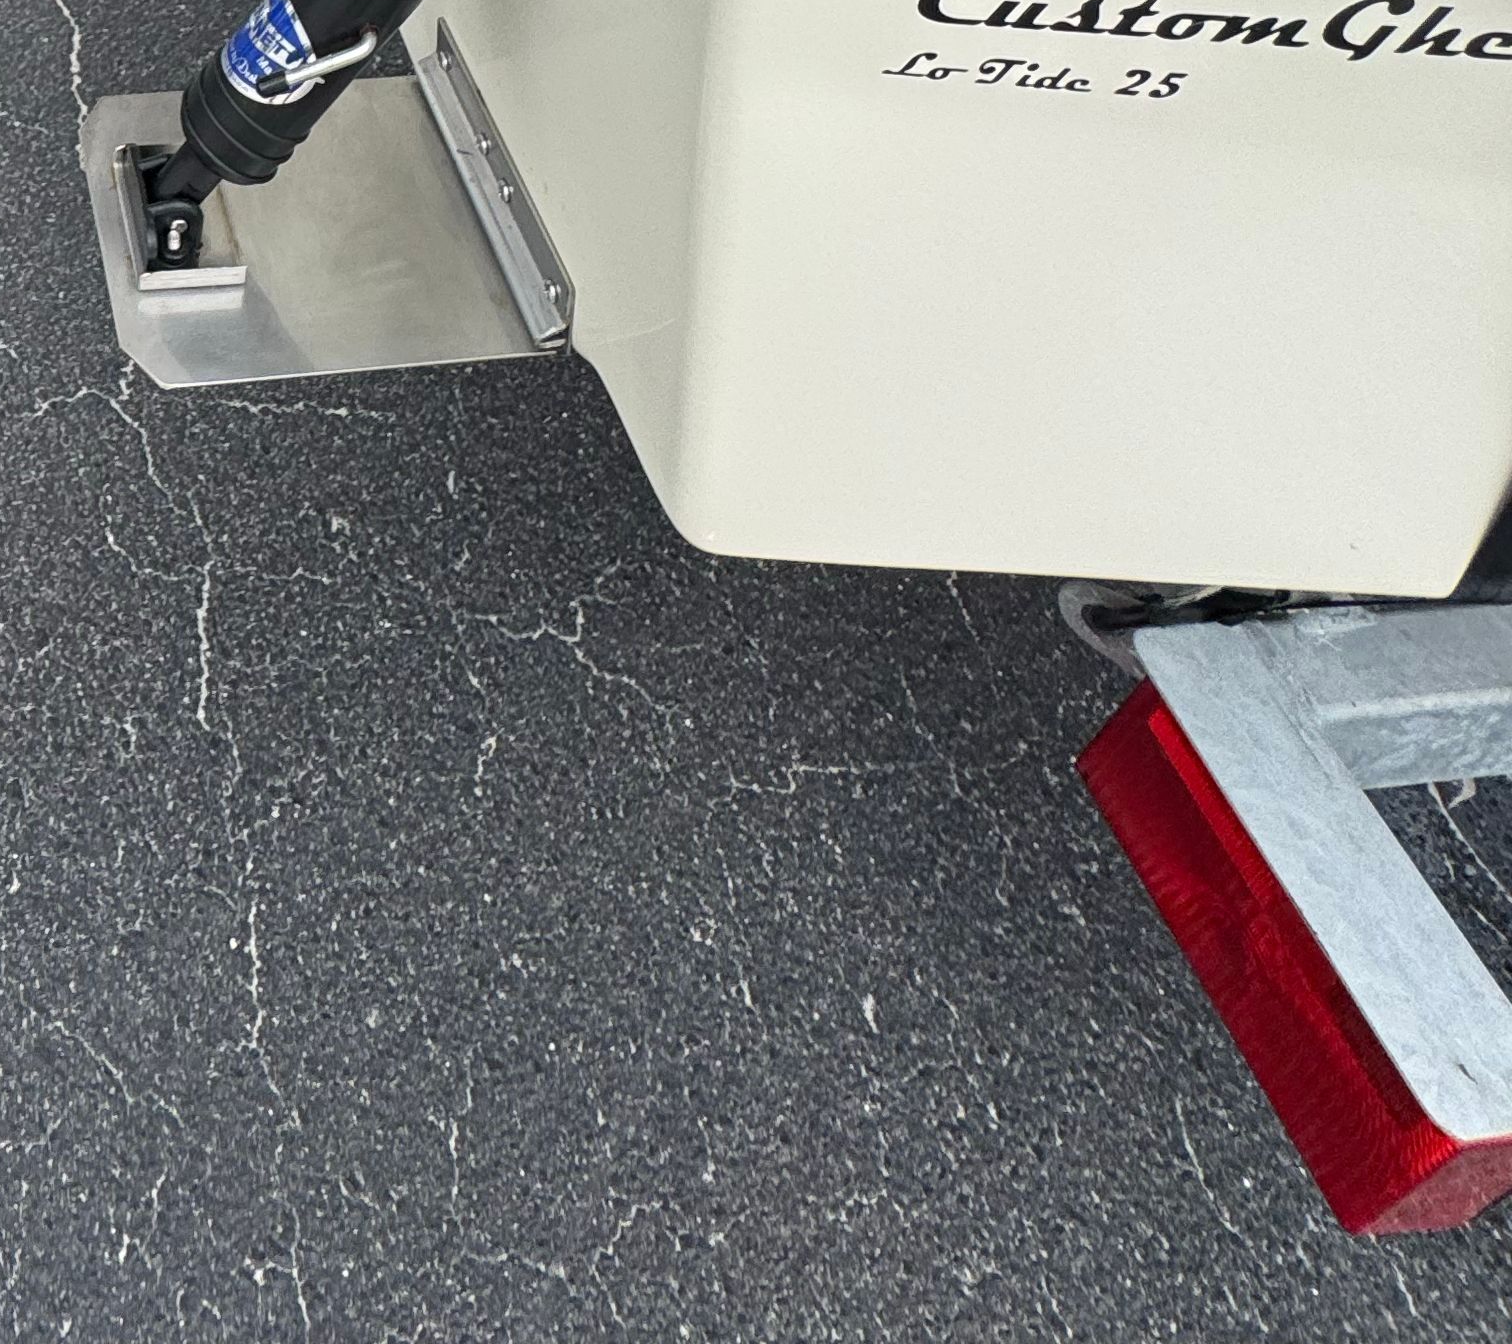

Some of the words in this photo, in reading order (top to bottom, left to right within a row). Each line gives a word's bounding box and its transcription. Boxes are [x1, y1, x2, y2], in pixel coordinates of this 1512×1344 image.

[882, 52, 969, 80] Lo
[975, 58, 1092, 92] Tide
[1114, 69, 1188, 98] 25
